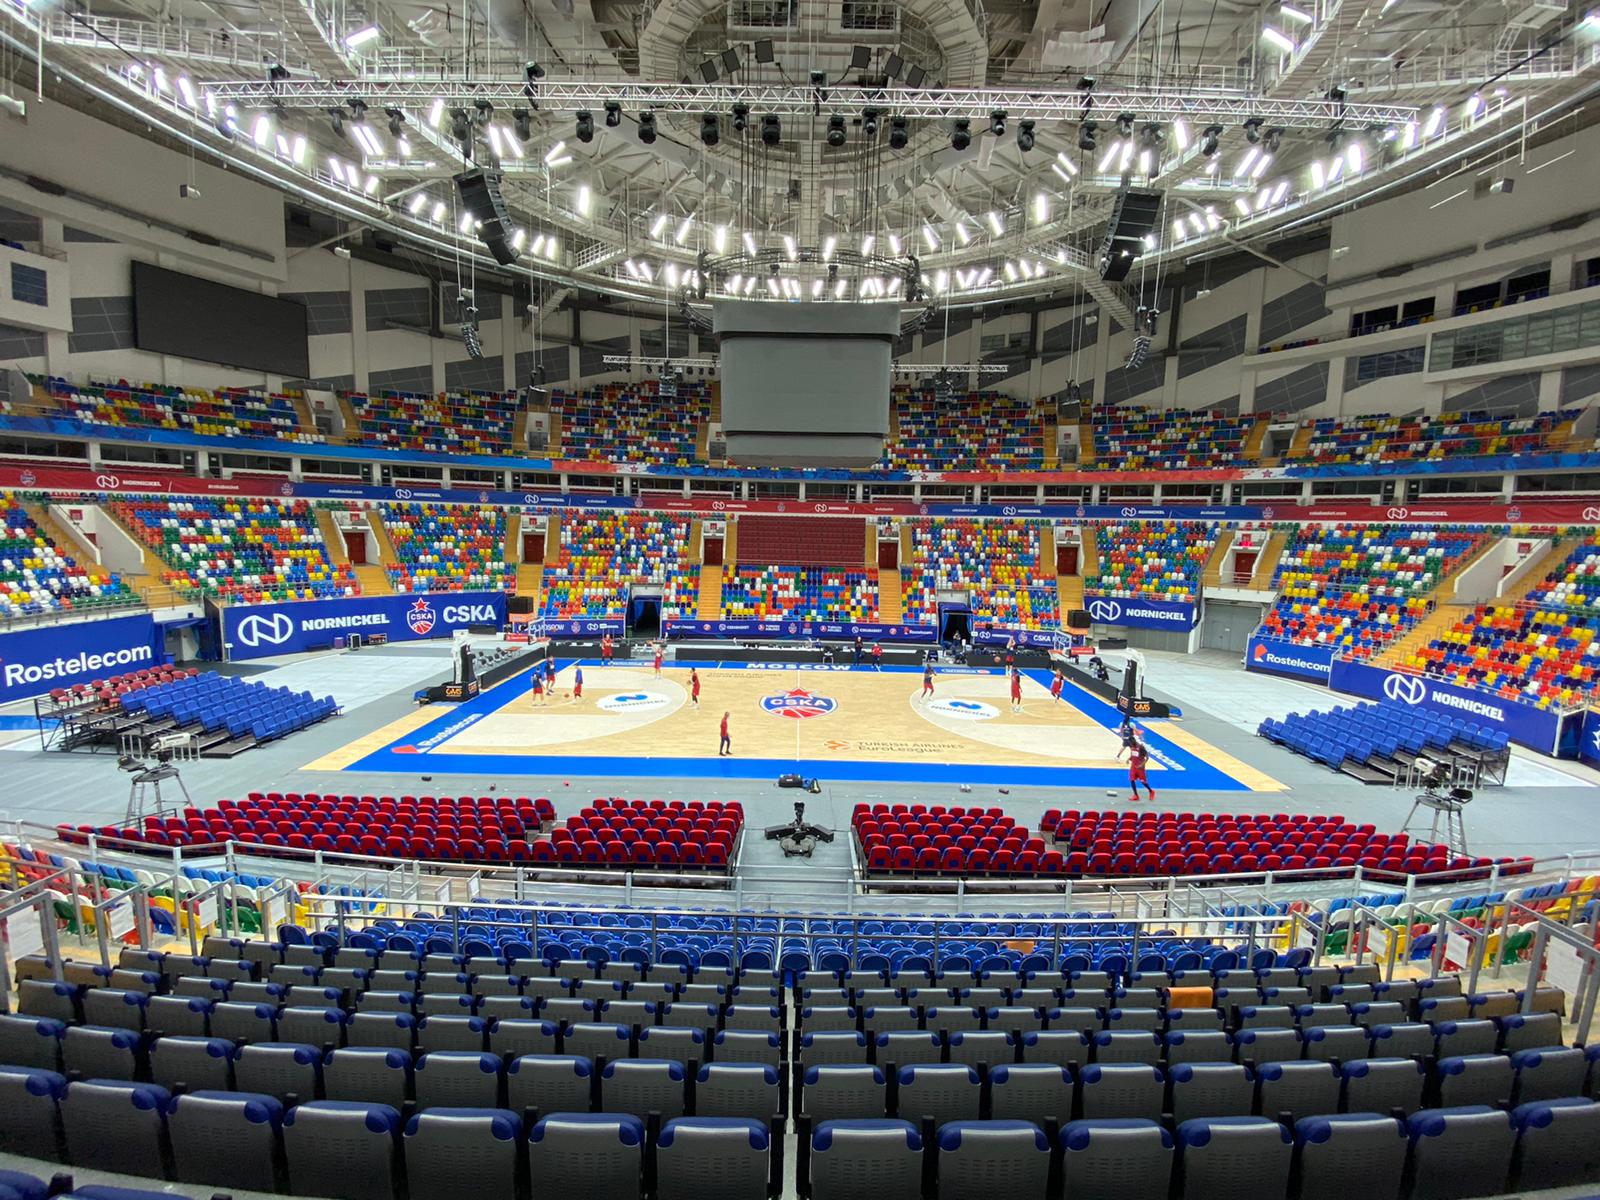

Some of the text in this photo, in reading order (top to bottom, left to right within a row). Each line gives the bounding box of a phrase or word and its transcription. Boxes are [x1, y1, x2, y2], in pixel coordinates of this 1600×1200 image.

[301, 613, 390, 631] NORNICKEL
[443, 604, 497, 623] CSKA
[1125, 608, 1186, 621] NORNICKEL
[4, 645, 152, 687] Rostelecom
[746, 663, 850, 671] MOSCOW
[1266, 653, 1331, 673] Rostelecom
[770, 698, 829, 707] CSKA
[1432, 690, 1504, 722] NORNICKEL
